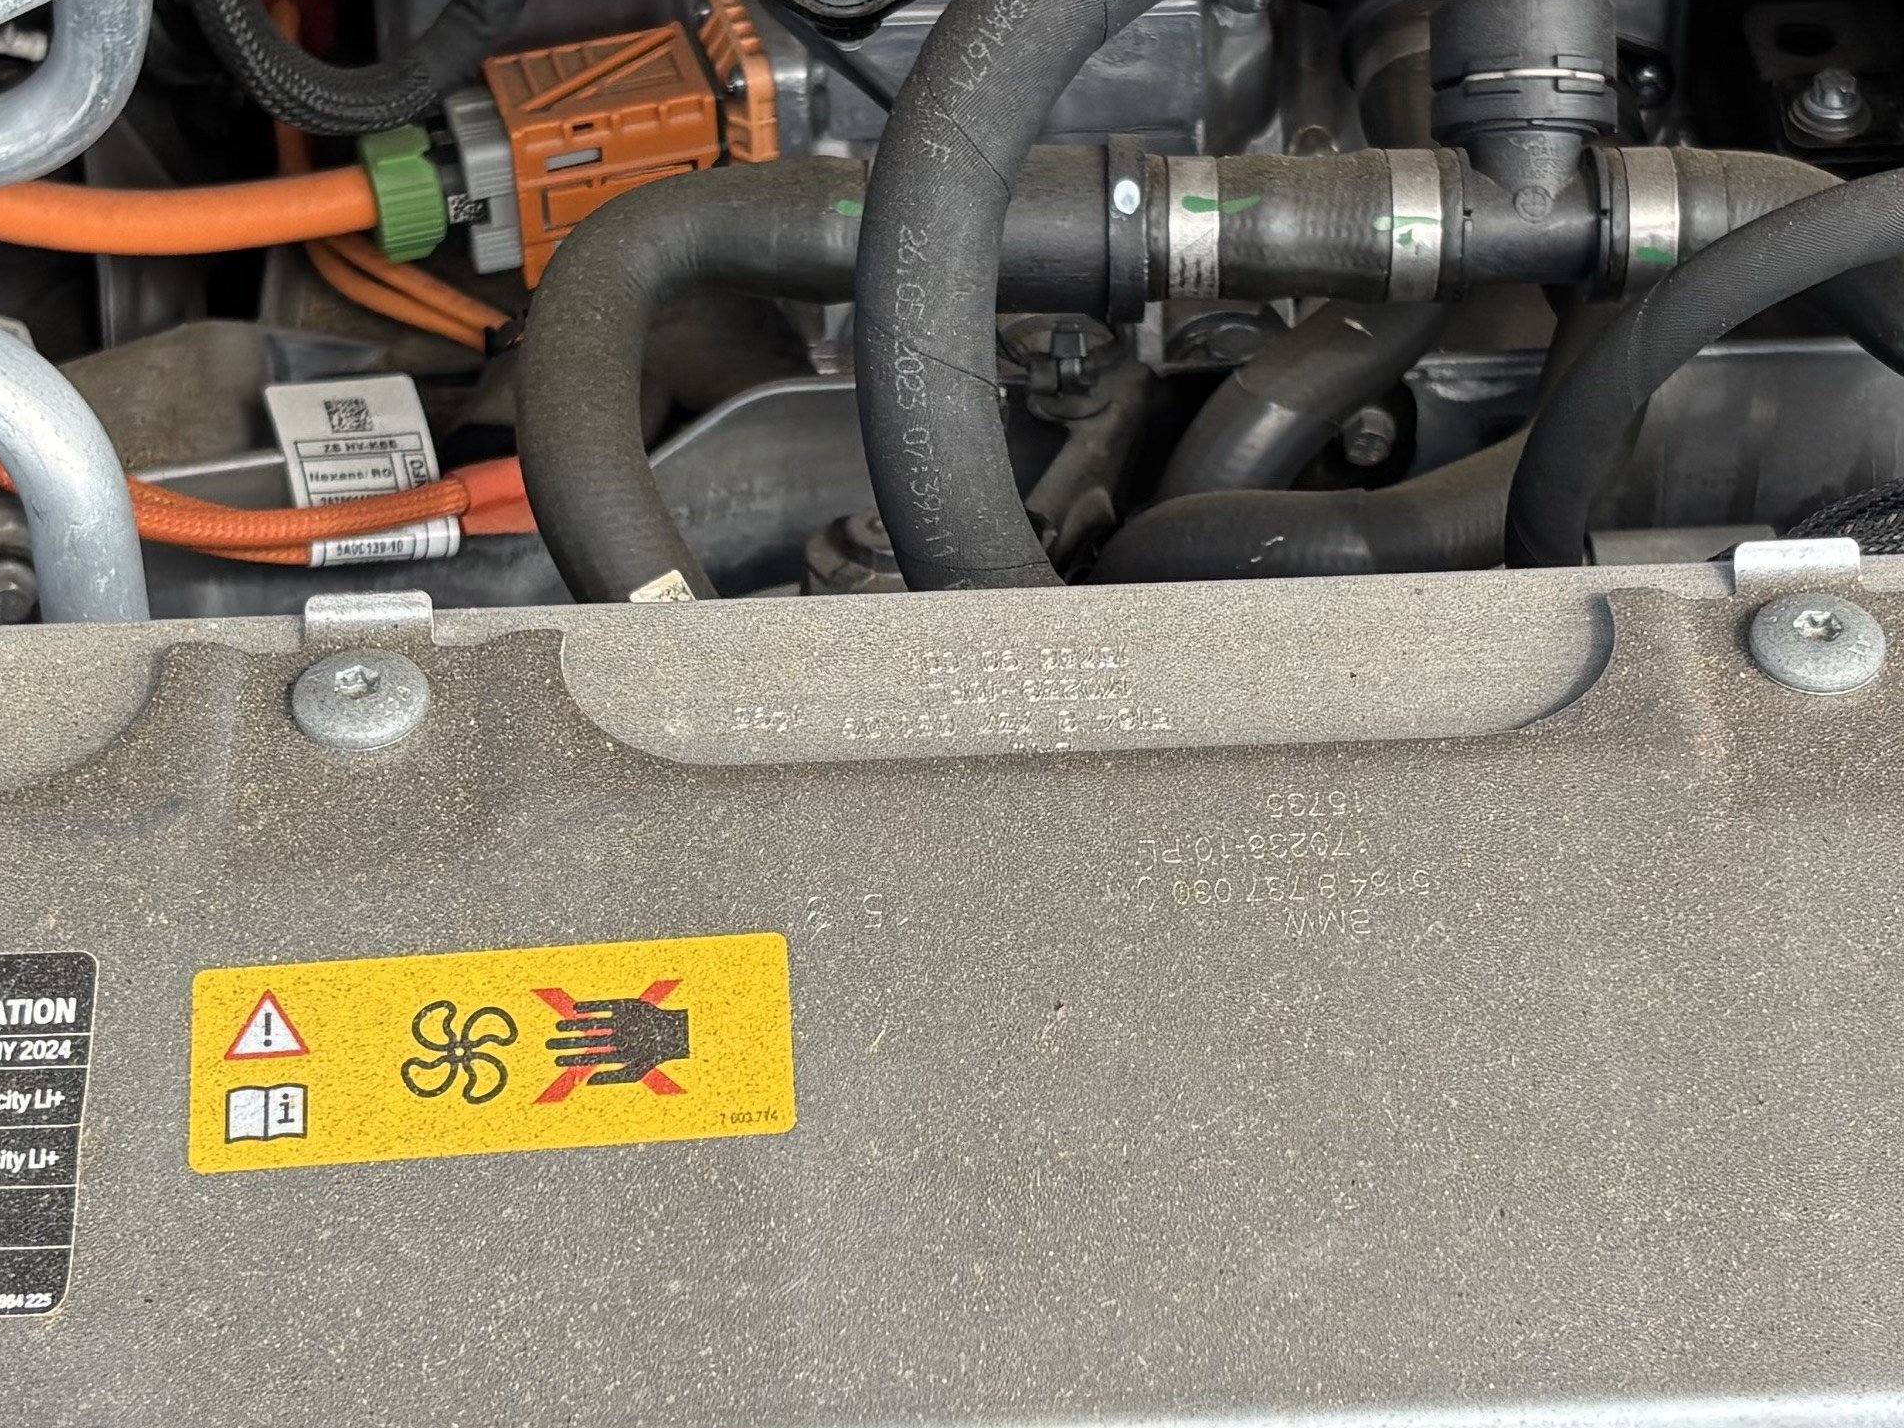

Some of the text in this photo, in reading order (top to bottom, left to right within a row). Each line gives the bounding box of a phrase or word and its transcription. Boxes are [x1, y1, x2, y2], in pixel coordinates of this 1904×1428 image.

[1283, 908, 1371, 936] BMW
[19, 1038, 74, 1061] 2024
[33, 1089, 67, 1111] Li+
[28, 1147, 61, 1170] Li+
[23, 1292, 53, 1309] 225
